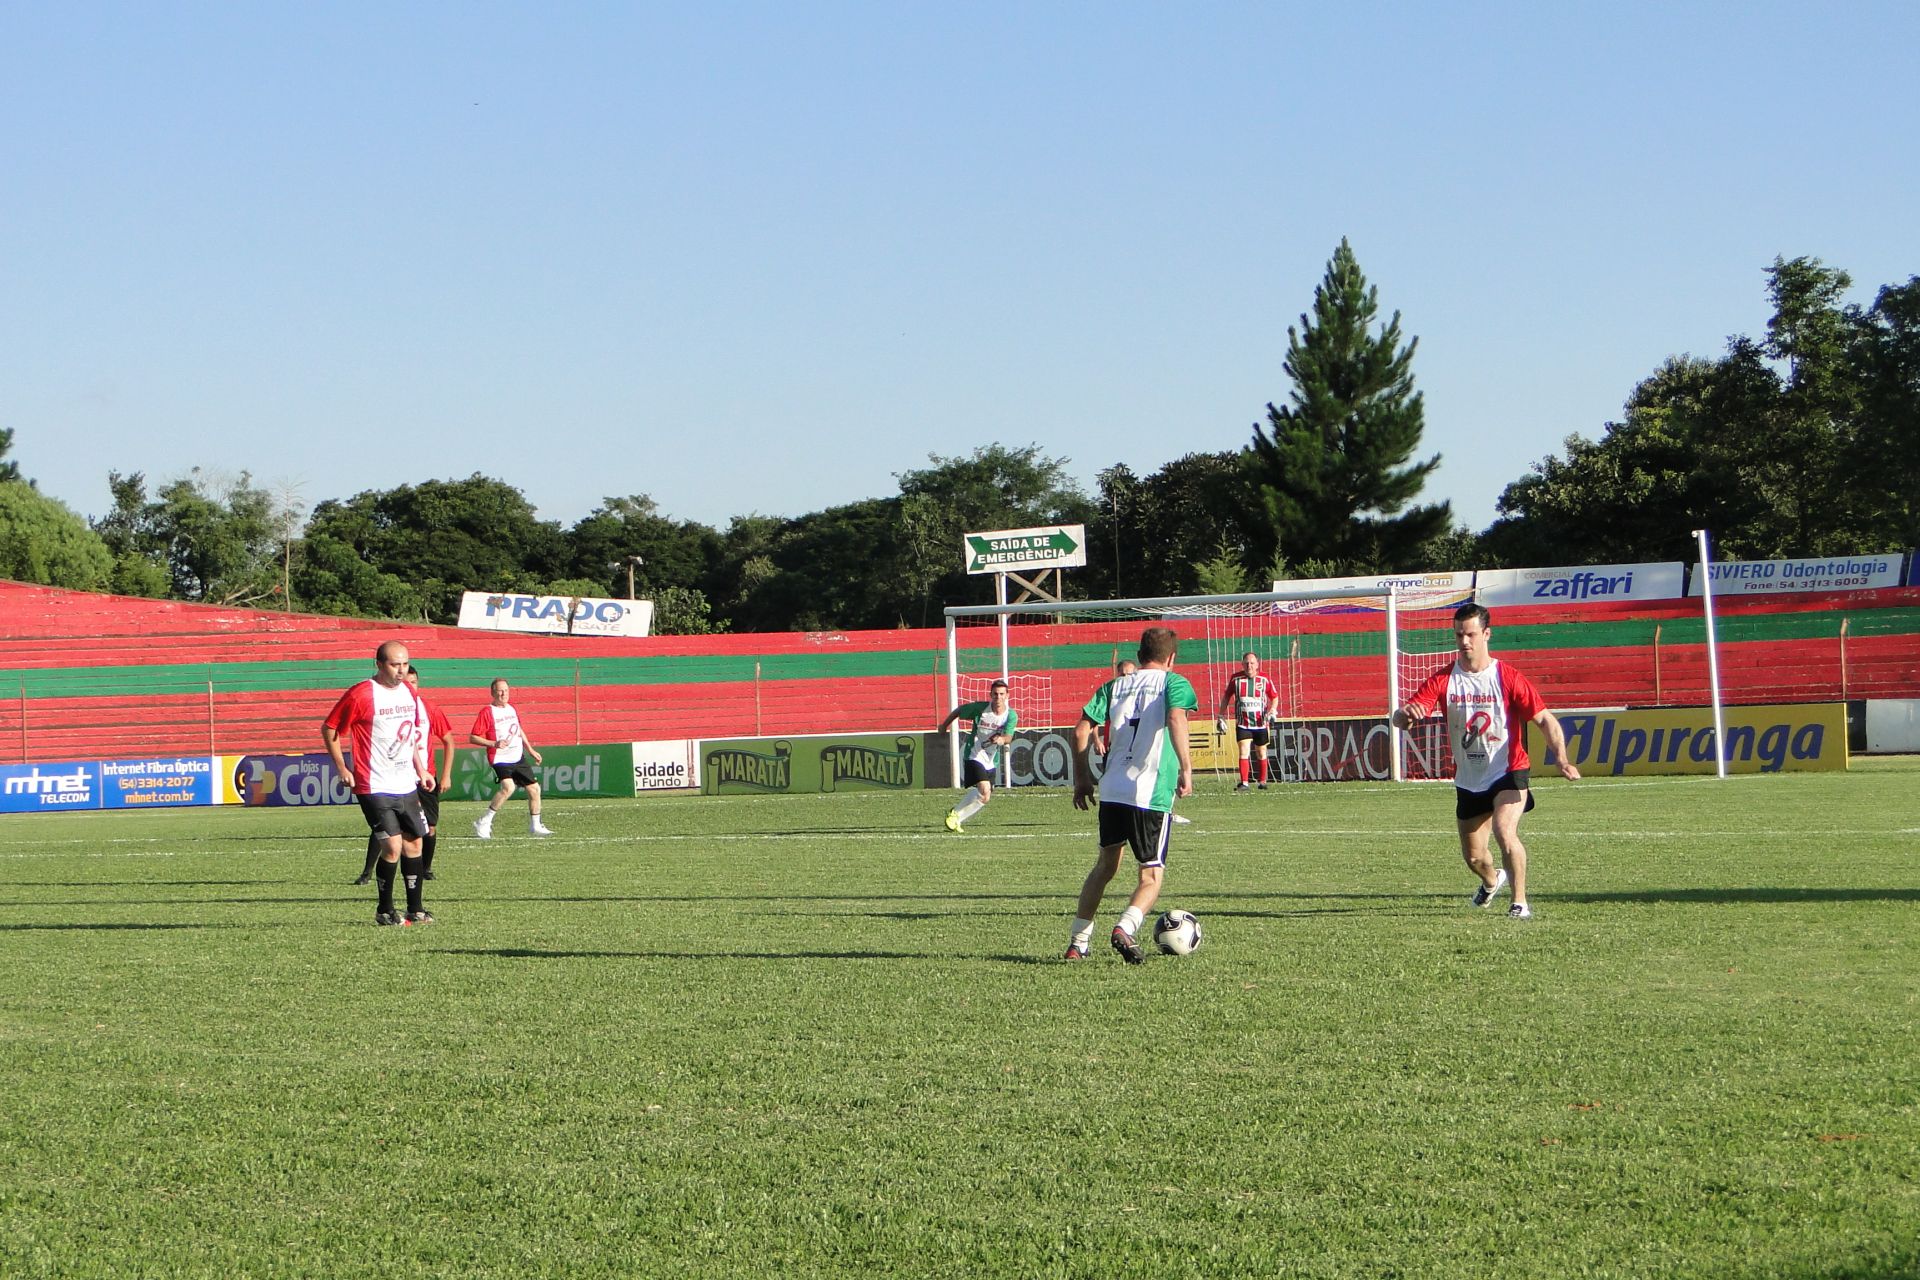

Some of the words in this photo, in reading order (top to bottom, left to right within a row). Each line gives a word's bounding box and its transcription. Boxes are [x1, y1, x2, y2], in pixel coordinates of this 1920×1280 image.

[991, 537, 1029, 551] SAÍDA
[1034, 536, 1050, 547] DE
[977, 548, 1066, 564] EMERGÊNCIA
[1707, 563, 1775, 580] SIVIERO
[1783, 558, 1888, 577] Odontologia
[1533, 571, 1633, 599] zaffari
[485, 596, 624, 623] PRADO
[1128, 717, 1141, 753] 7
[1267, 723, 1441, 783] ERRACNI
[1597, 718, 1824, 777] Ipiranga
[103, 762, 146, 776] Internet
[147, 761, 175, 774] Fibra
[175, 758, 210, 775] Óptica
[300, 760, 320, 775] lojas
[720, 751, 788, 788] MARATÁ
[837, 749, 913, 785] MARATÁ
[5, 766, 92, 795] mhnet
[118, 777, 137, 790] (54)
[138, 776, 195, 788] 3314-2077
[280, 764, 359, 806] Colo
[642, 777, 682, 788] Fundo
[40, 792, 90, 805] TELECOM
[125, 789, 195, 804] mhnet.com.br
